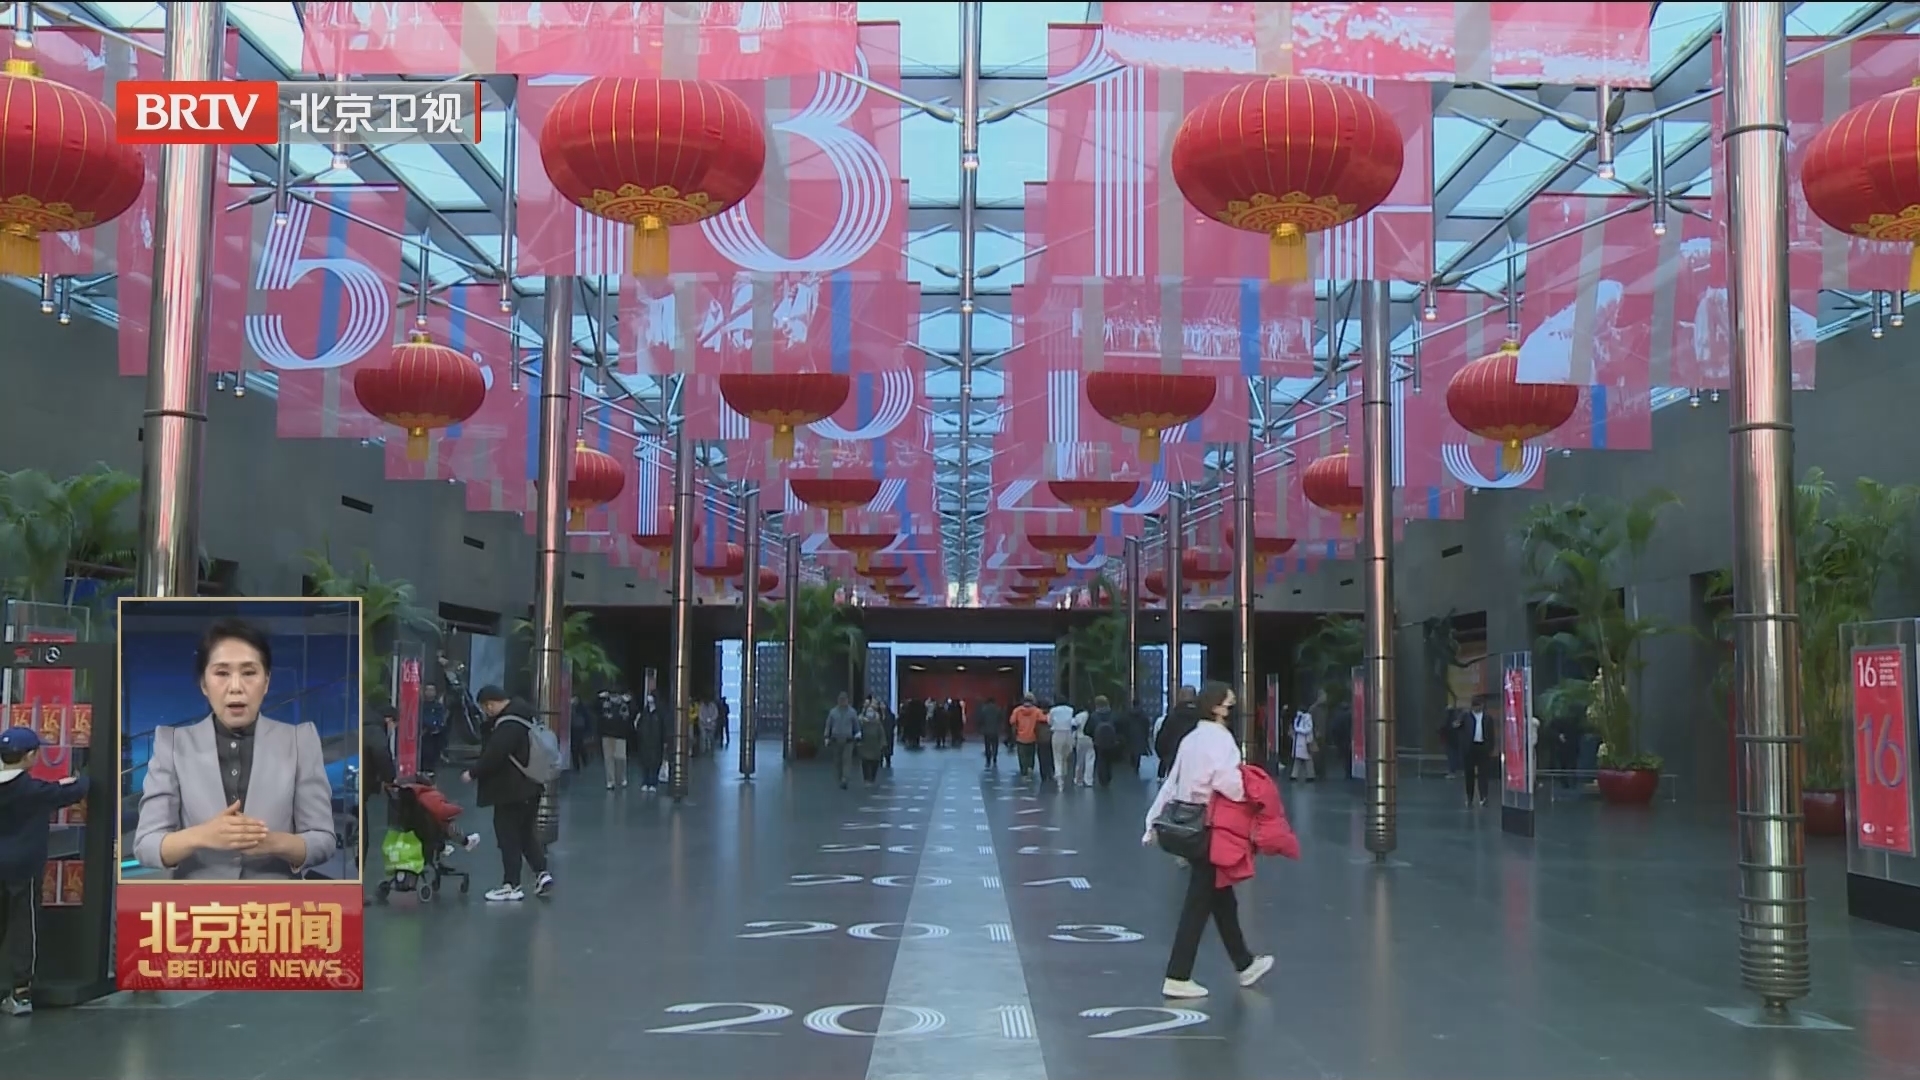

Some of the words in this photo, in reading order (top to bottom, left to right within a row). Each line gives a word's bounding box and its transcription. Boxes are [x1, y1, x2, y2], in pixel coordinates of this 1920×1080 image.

[1857, 656, 1878, 688] 16
[1858, 713, 1904, 788] 16
[735, 920, 1146, 943] 2013
[644, 1002, 1226, 1041] 2012
